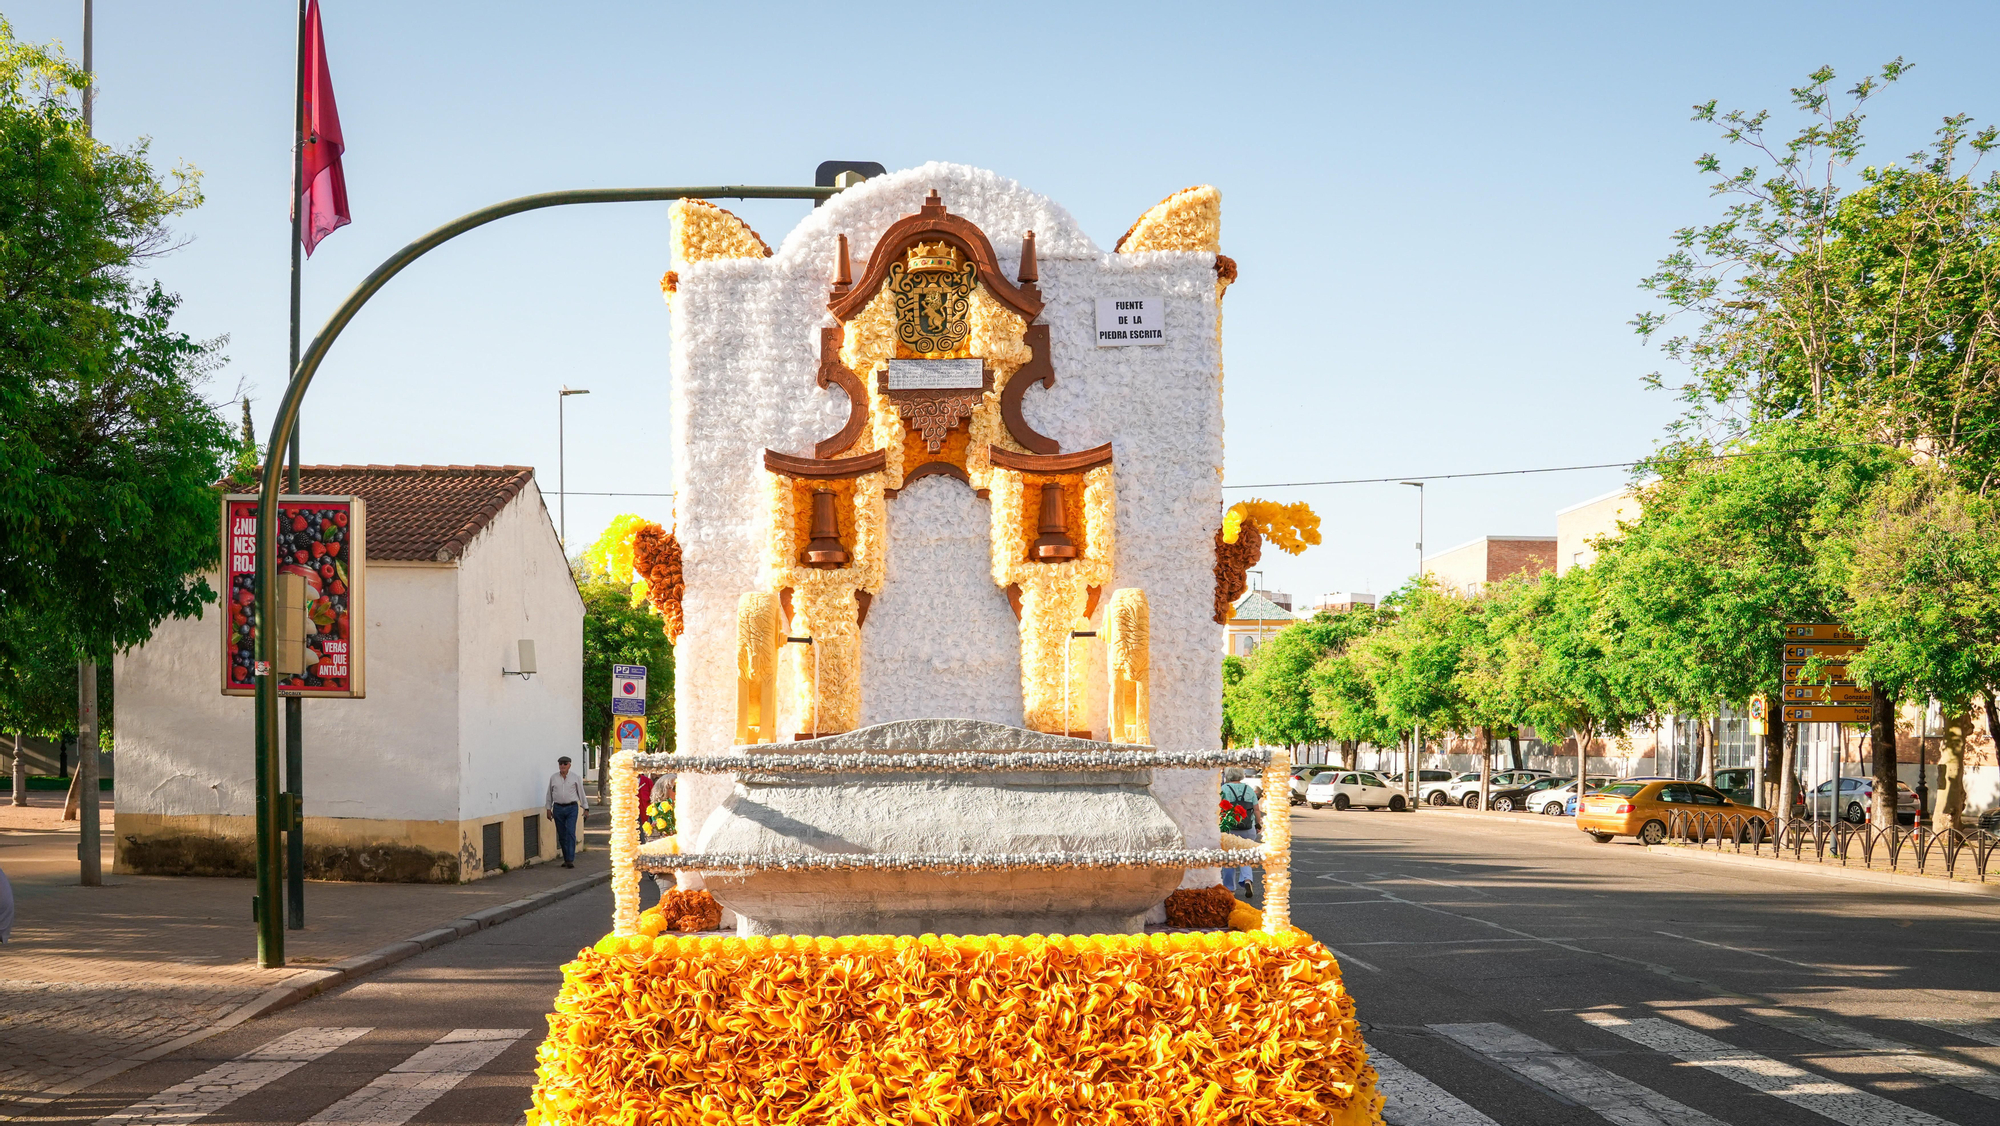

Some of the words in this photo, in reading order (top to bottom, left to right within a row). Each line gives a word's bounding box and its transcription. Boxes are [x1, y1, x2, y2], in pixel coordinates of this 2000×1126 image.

[1115, 301, 1143, 310] FUENTE
[1118, 316, 1128, 325] DE
[1133, 315, 1142, 324] LA
[1099, 331, 1127, 340] PIEDRA
[1130, 329, 1162, 339] ESCRITA
[233, 518, 257, 536] ¿NU
[233, 536, 256, 554] NES
[233, 555, 256, 572] ROJ
[324, 641, 347, 653] VERÁS
[332, 654, 347, 667] QUE
[319, 665, 347, 676] ANTOJO
